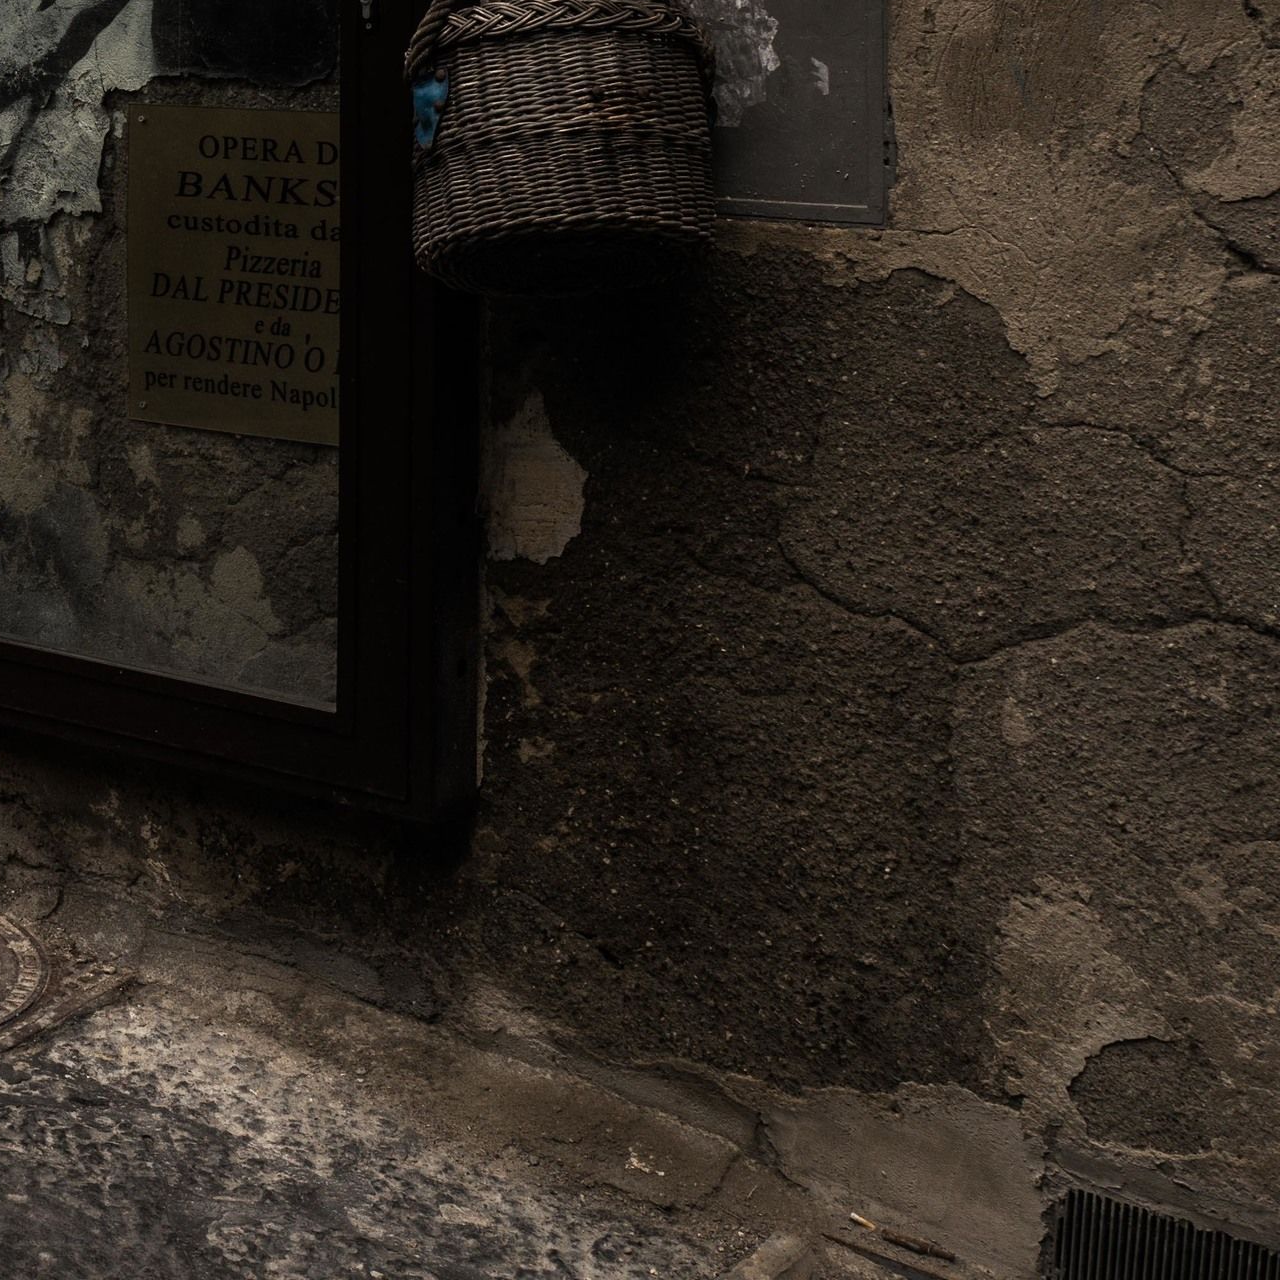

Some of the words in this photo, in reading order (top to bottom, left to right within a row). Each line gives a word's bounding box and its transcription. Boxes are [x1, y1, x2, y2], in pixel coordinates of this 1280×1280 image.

[198, 134, 305, 166] OPERA
[174, 170, 338, 208] BANKS
[166, 213, 299, 241] custodita
[223, 245, 323, 279] Pizzeria
[150, 272, 209, 302] DAL
[217, 280, 341, 315] PRESIDE
[254, 318, 265, 335] e
[270, 315, 291, 337] da
[144, 329, 295, 370] AGOSTINO
[144, 369, 178, 391] per
[183, 373, 263, 401] rendere
[269, 380, 337, 412] Napol
